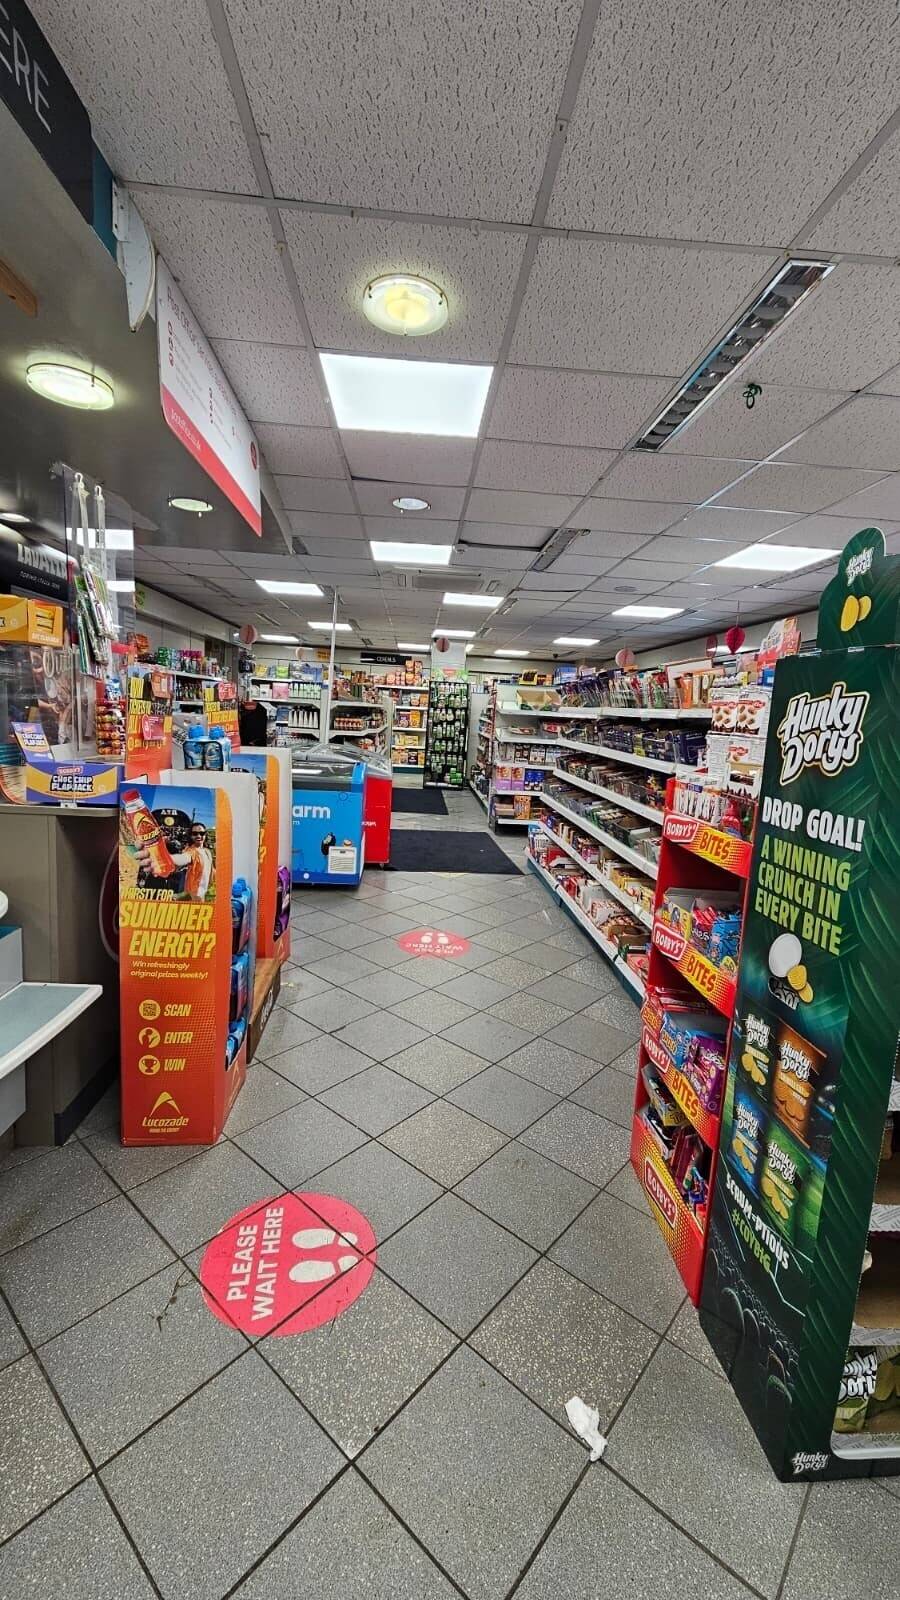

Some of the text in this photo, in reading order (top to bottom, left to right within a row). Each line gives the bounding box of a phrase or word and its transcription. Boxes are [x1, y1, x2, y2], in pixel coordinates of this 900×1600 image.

[781, 684, 866, 742] Hunky
[781, 731, 860, 782] Dorys
[51, 783, 93, 792] FLAPJACK
[52, 775, 93, 784] CHOC CHIP
[667, 822, 697, 837] BOBBY'S
[761, 796, 866, 852] DROP GOAL!
[699, 831, 731, 860] BITES
[760, 834, 851, 892] A WINNING
[120, 888, 174, 901] THIRSTY FOR
[758, 861, 840, 921] CRUNCH IN
[119, 901, 214, 931] SUMMER
[755, 887, 843, 956] EVERY BITE
[128, 930, 217, 959] ENERGY?
[656, 930, 683, 954] BOBBY'S
[130, 970, 209, 980] original prizes weekly!
[147, 962, 190, 971] refreshingly
[686, 955, 716, 992] BITES
[164, 1004, 192, 1017] SCAN
[164, 1032, 193, 1044] ENTER
[164, 1059, 186, 1071] WIN
[781, 1040, 810, 1068] Hunky
[781, 1055, 810, 1081] Dorys
[671, 1071, 699, 1118] BITES
[142, 1115, 189, 1127] Lucozade
[768, 1141, 798, 1172] Hunky
[768, 1154, 796, 1184] Dorys
[226, 1225, 258, 1301] PLEASE
[251, 1207, 284, 1321] WAIT HERE
[844, 1352, 877, 1376] unky
[793, 1452, 829, 1466] Hunky
[793, 1461, 826, 1474] Dorys
